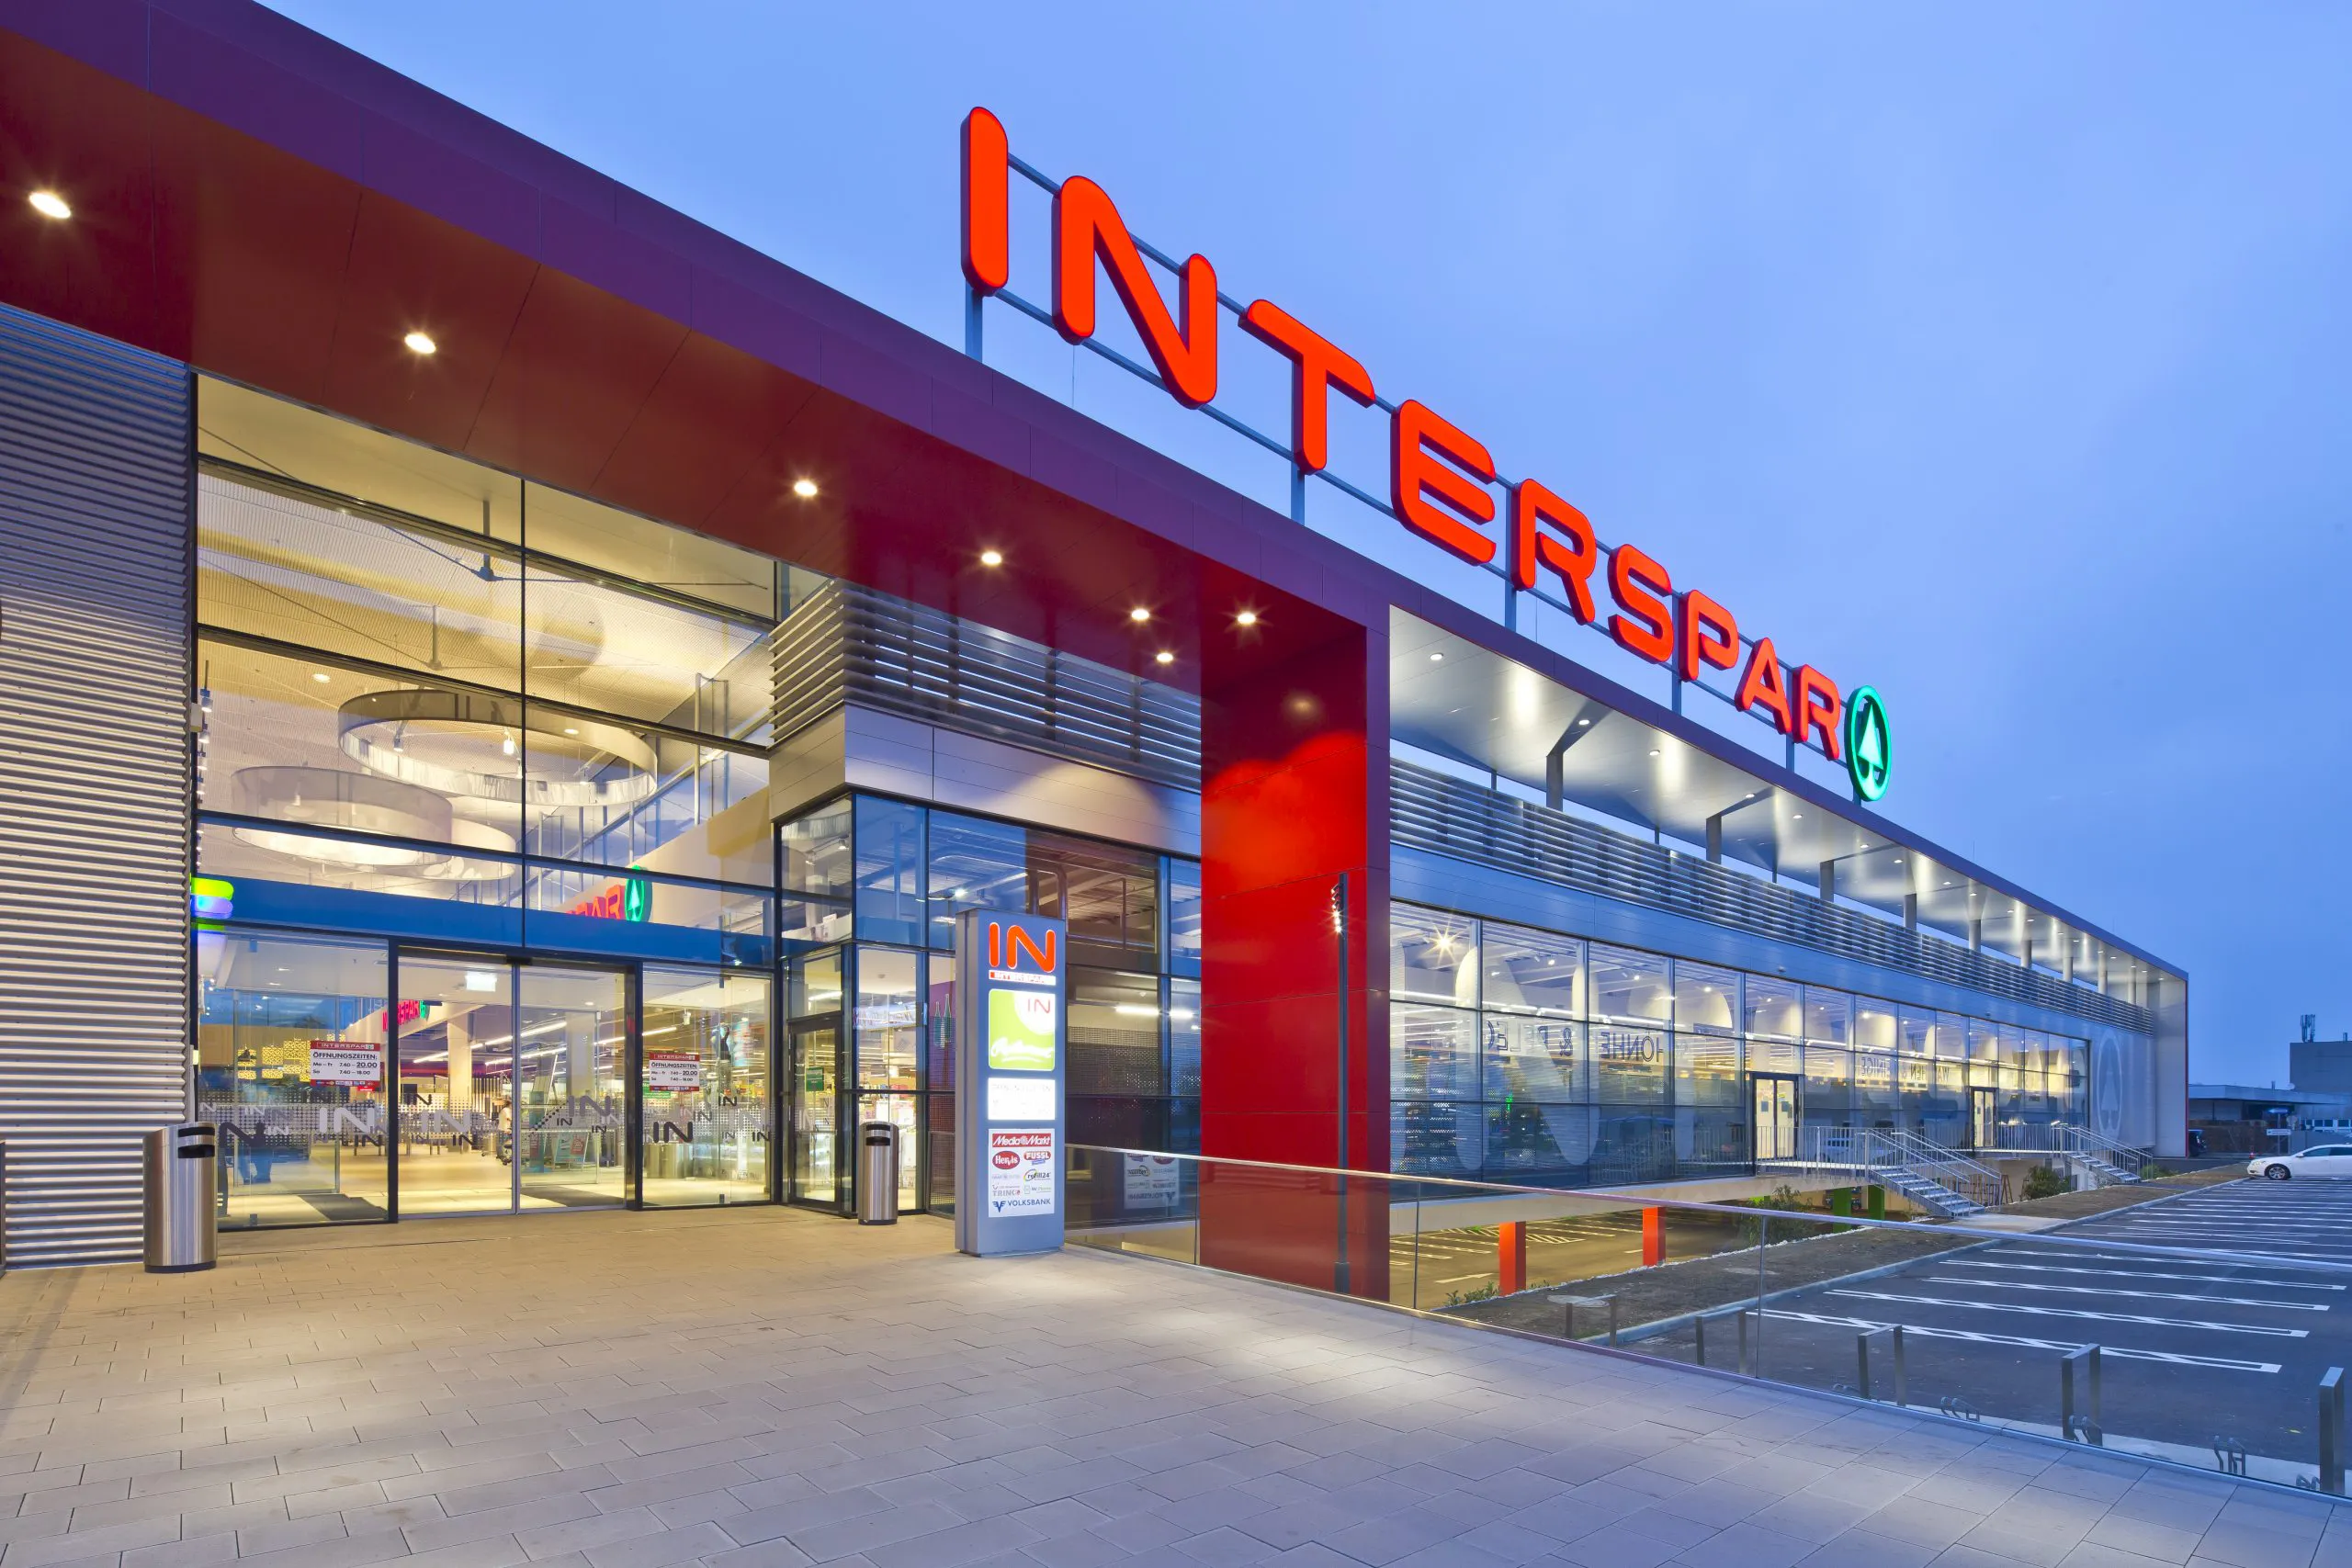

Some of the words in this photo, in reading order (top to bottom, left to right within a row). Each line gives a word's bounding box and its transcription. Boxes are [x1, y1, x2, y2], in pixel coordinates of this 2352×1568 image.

[960, 106, 1841, 761] INTERSPAR
[989, 922, 1056, 973] IN
[1027, 998, 1051, 1014] IN
[312, 1052, 378, 1061] ÖFFNUNGSZEITEN:
[319, 1106, 375, 1134] IN
[556, 1117, 573, 1126] IN
[652, 1121, 694, 1144] IN
[995, 1154, 1018, 1166] Hervis
[1025, 1151, 1050, 1159] FUSSL
[1007, 1198, 1051, 1207] VOLKSBANK
